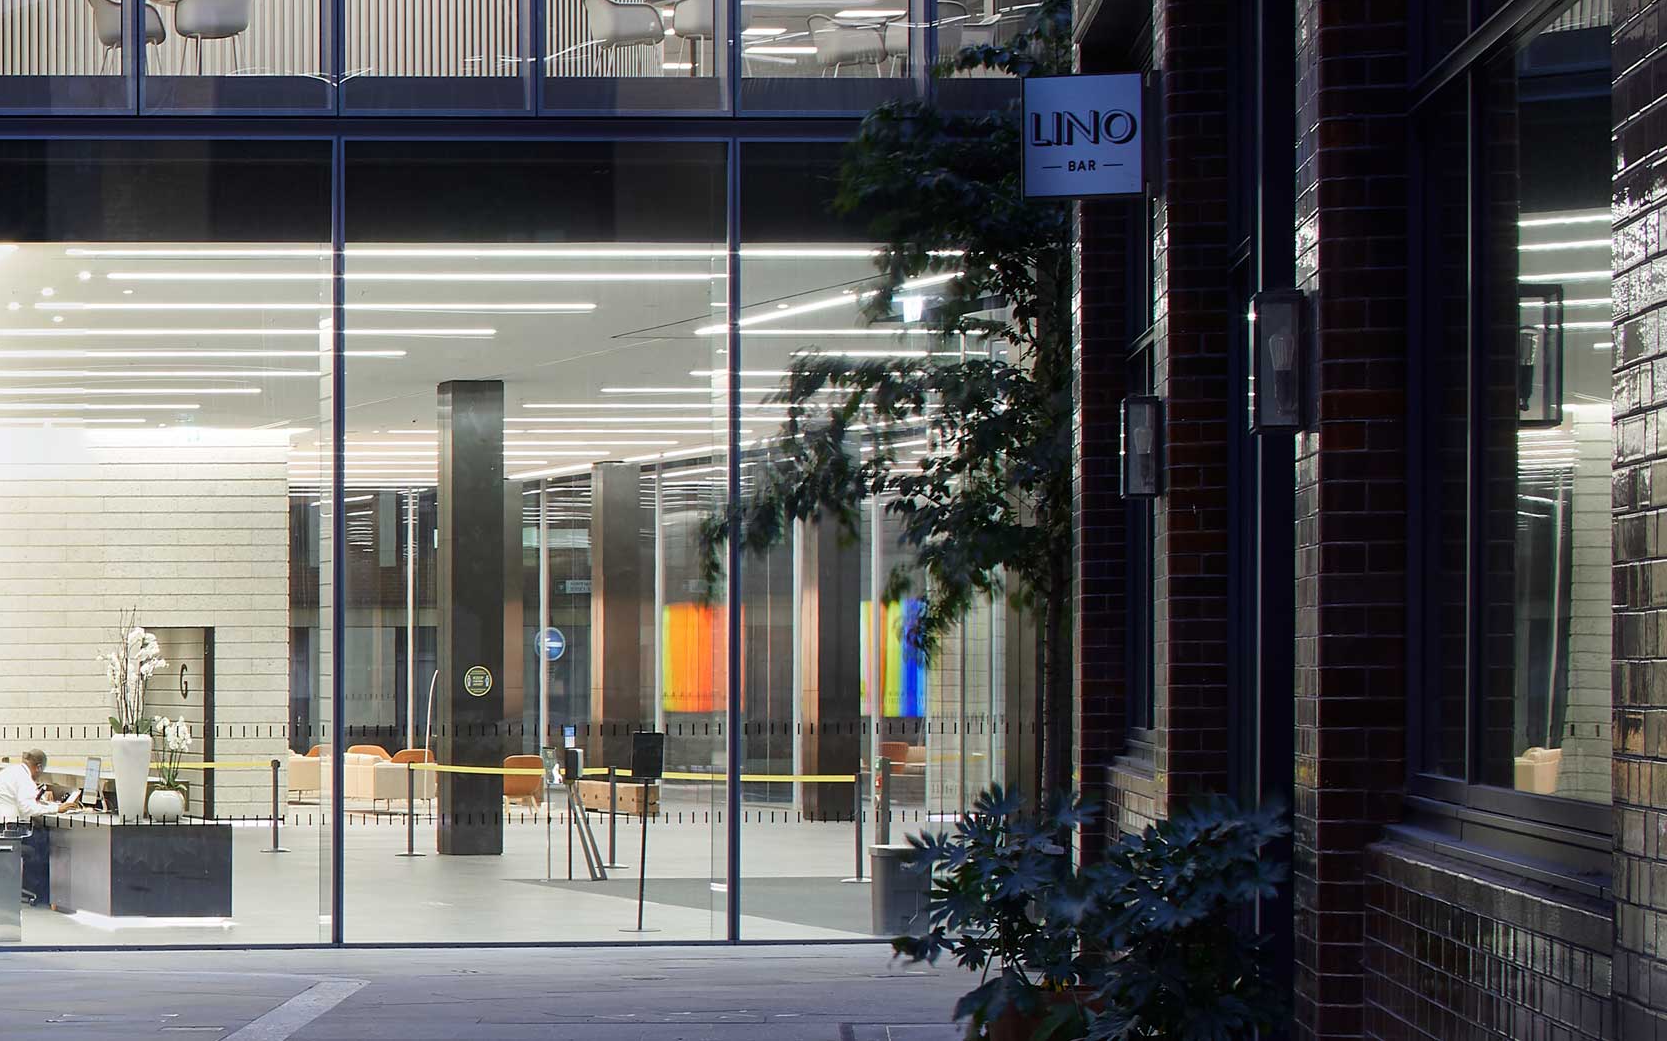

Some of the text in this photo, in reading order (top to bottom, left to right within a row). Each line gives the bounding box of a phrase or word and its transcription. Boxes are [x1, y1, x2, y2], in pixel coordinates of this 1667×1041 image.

[1030, 108, 1137, 147] LINO
[1068, 160, 1096, 172] BAR
[179, 663, 188, 699] G
